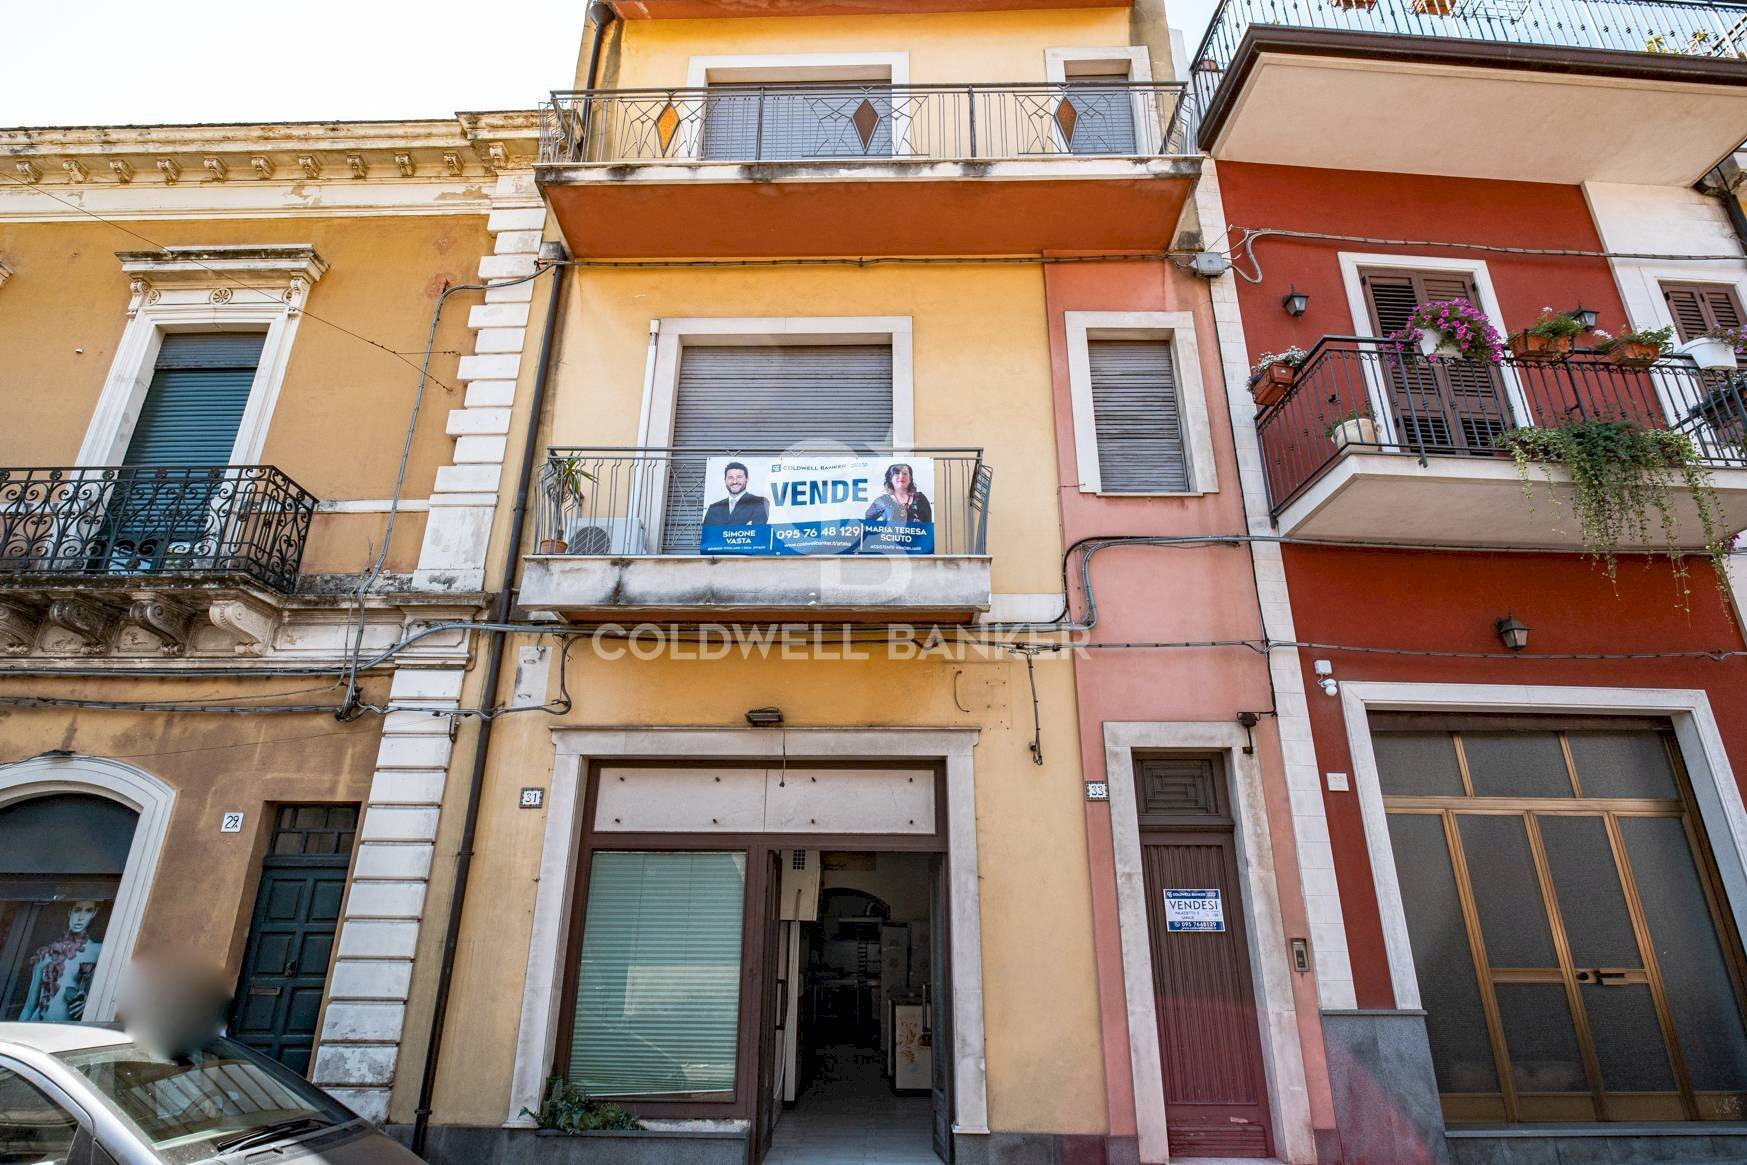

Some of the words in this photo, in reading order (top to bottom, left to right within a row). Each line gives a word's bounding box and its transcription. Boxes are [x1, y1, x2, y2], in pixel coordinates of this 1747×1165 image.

[770, 478, 869, 507] VENDE
[722, 529, 756, 538] SIMONE
[776, 529, 801, 539] 095
[803, 528, 818, 538] 76
[821, 526, 837, 536] 48
[840, 526, 860, 537] 129
[865, 525, 893, 533] MARIA
[895, 526, 927, 536] TERESA
[880, 533, 912, 543] SCIUTO
[1091, 785, 1104, 796] 33
[525, 792, 537, 803] 31
[1169, 900, 1218, 910] VENDESI
